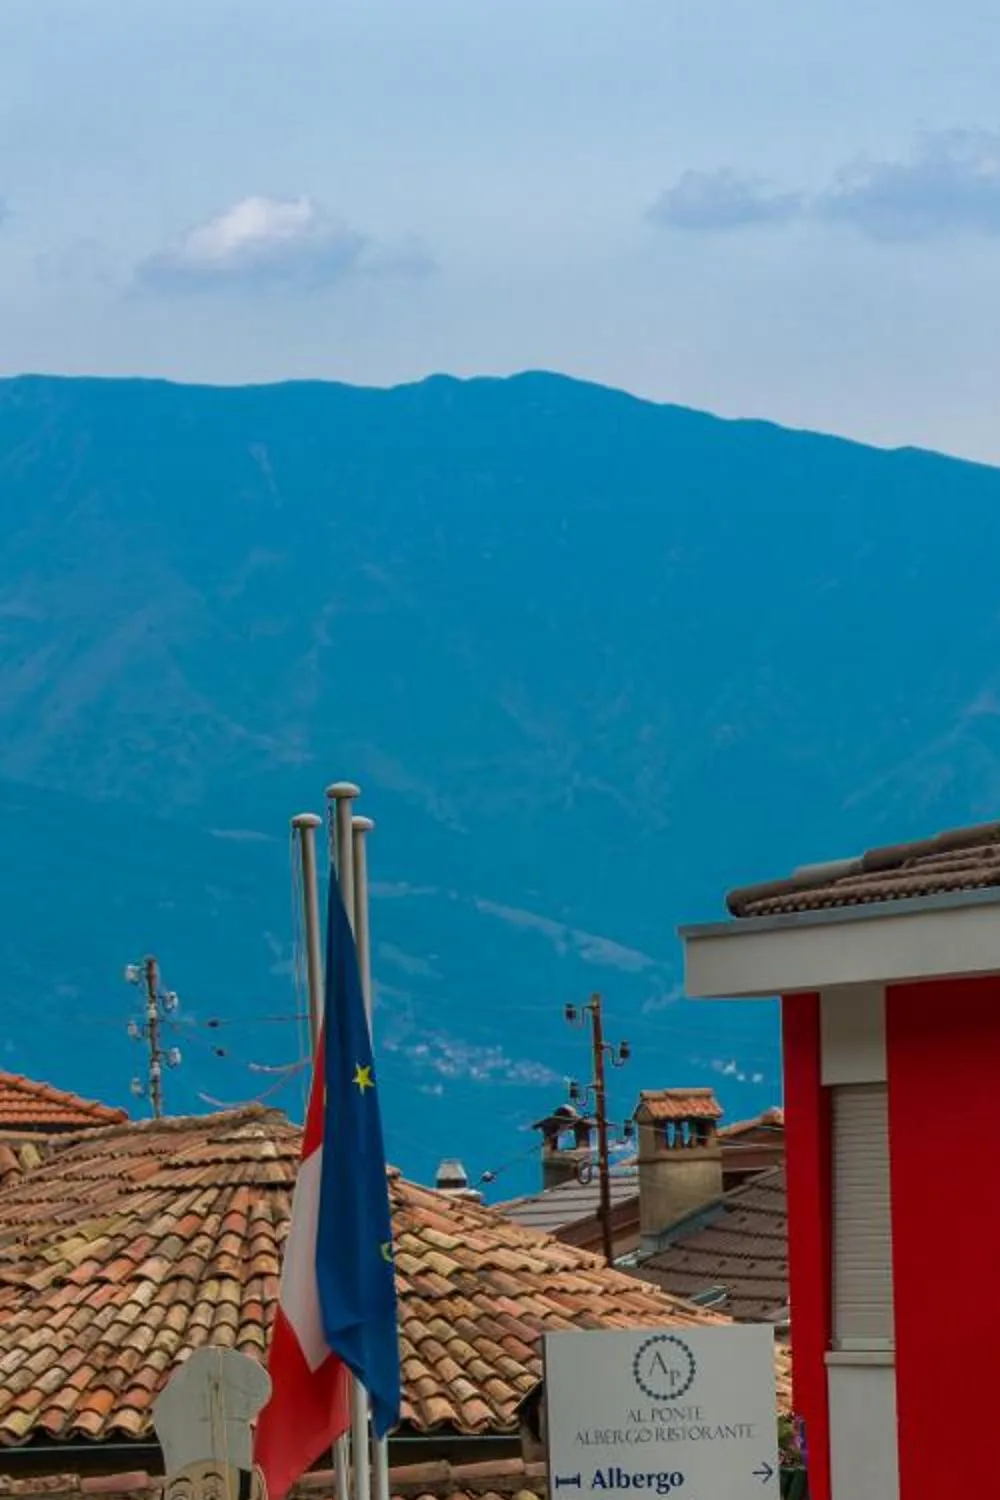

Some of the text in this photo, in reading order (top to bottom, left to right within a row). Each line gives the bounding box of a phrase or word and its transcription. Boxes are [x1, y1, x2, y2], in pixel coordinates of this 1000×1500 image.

[626, 1406, 703, 1423] AL PONTE
[575, 1423, 757, 1446] ALBERGO RISTORANTE
[591, 1467, 685, 1495] Albergo
